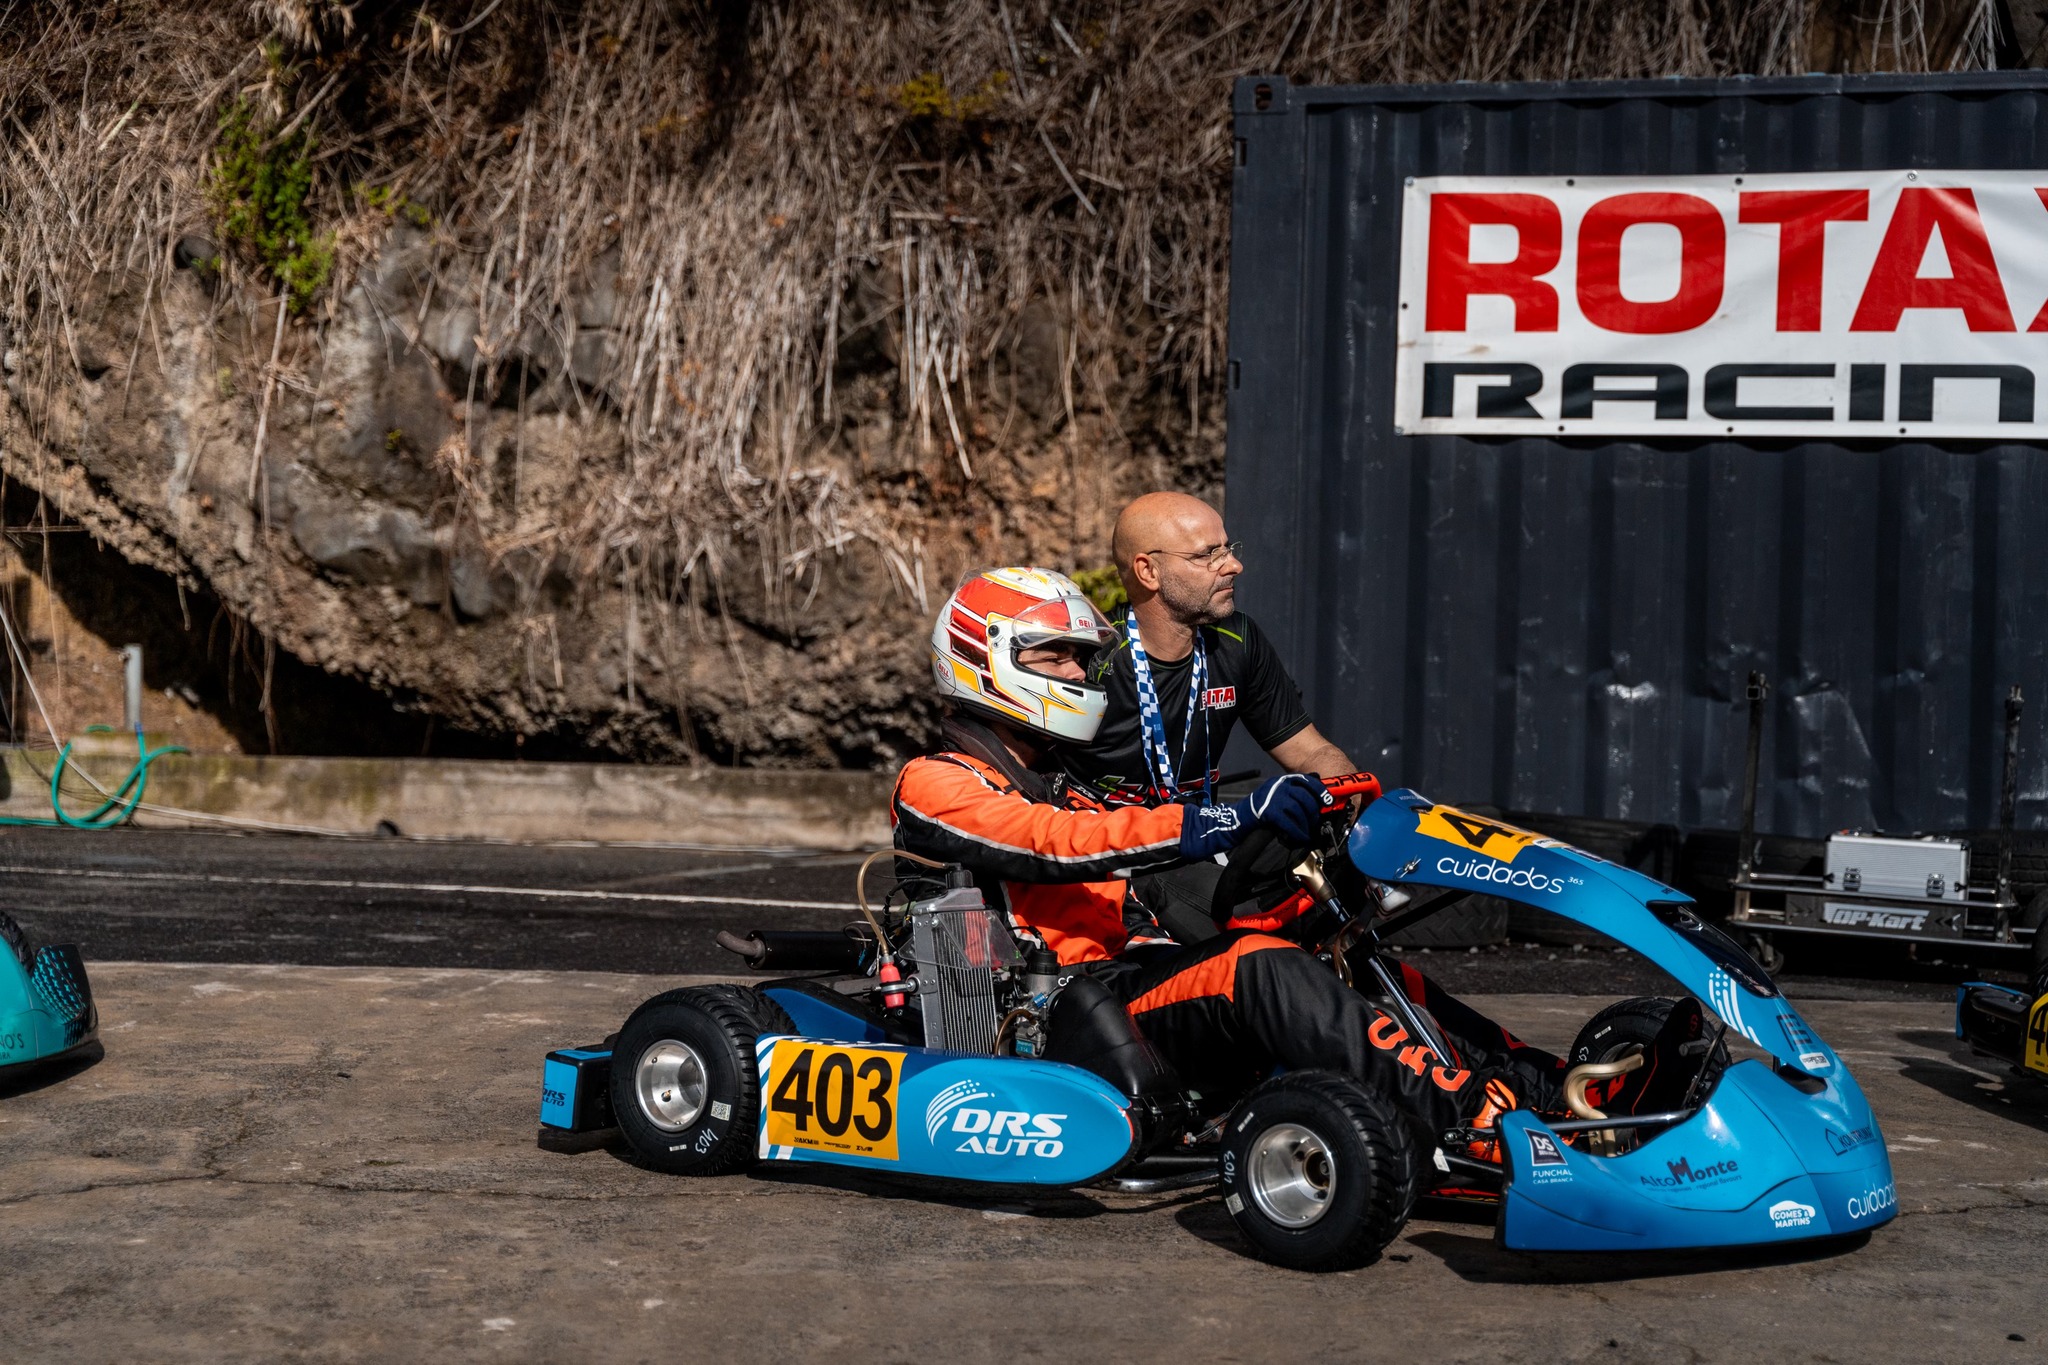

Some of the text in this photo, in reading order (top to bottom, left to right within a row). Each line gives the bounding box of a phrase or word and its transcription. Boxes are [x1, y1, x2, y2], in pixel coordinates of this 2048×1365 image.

[1436, 857, 1565, 894] cuidados
[1577, 1046, 1590, 1062] 03
[771, 1048, 893, 1142] 403
[951, 1107, 1068, 1138] DRS
[695, 1128, 719, 1154] 403
[955, 1136, 1064, 1158] AUTO
[1532, 1135, 1555, 1151] DS
[1223, 1149, 1236, 1184] 403
[1532, 1169, 1573, 1178] FUNCHAL
[1774, 1209, 1802, 1220] GOMES
[1775, 1217, 1811, 1228] MARTINS
